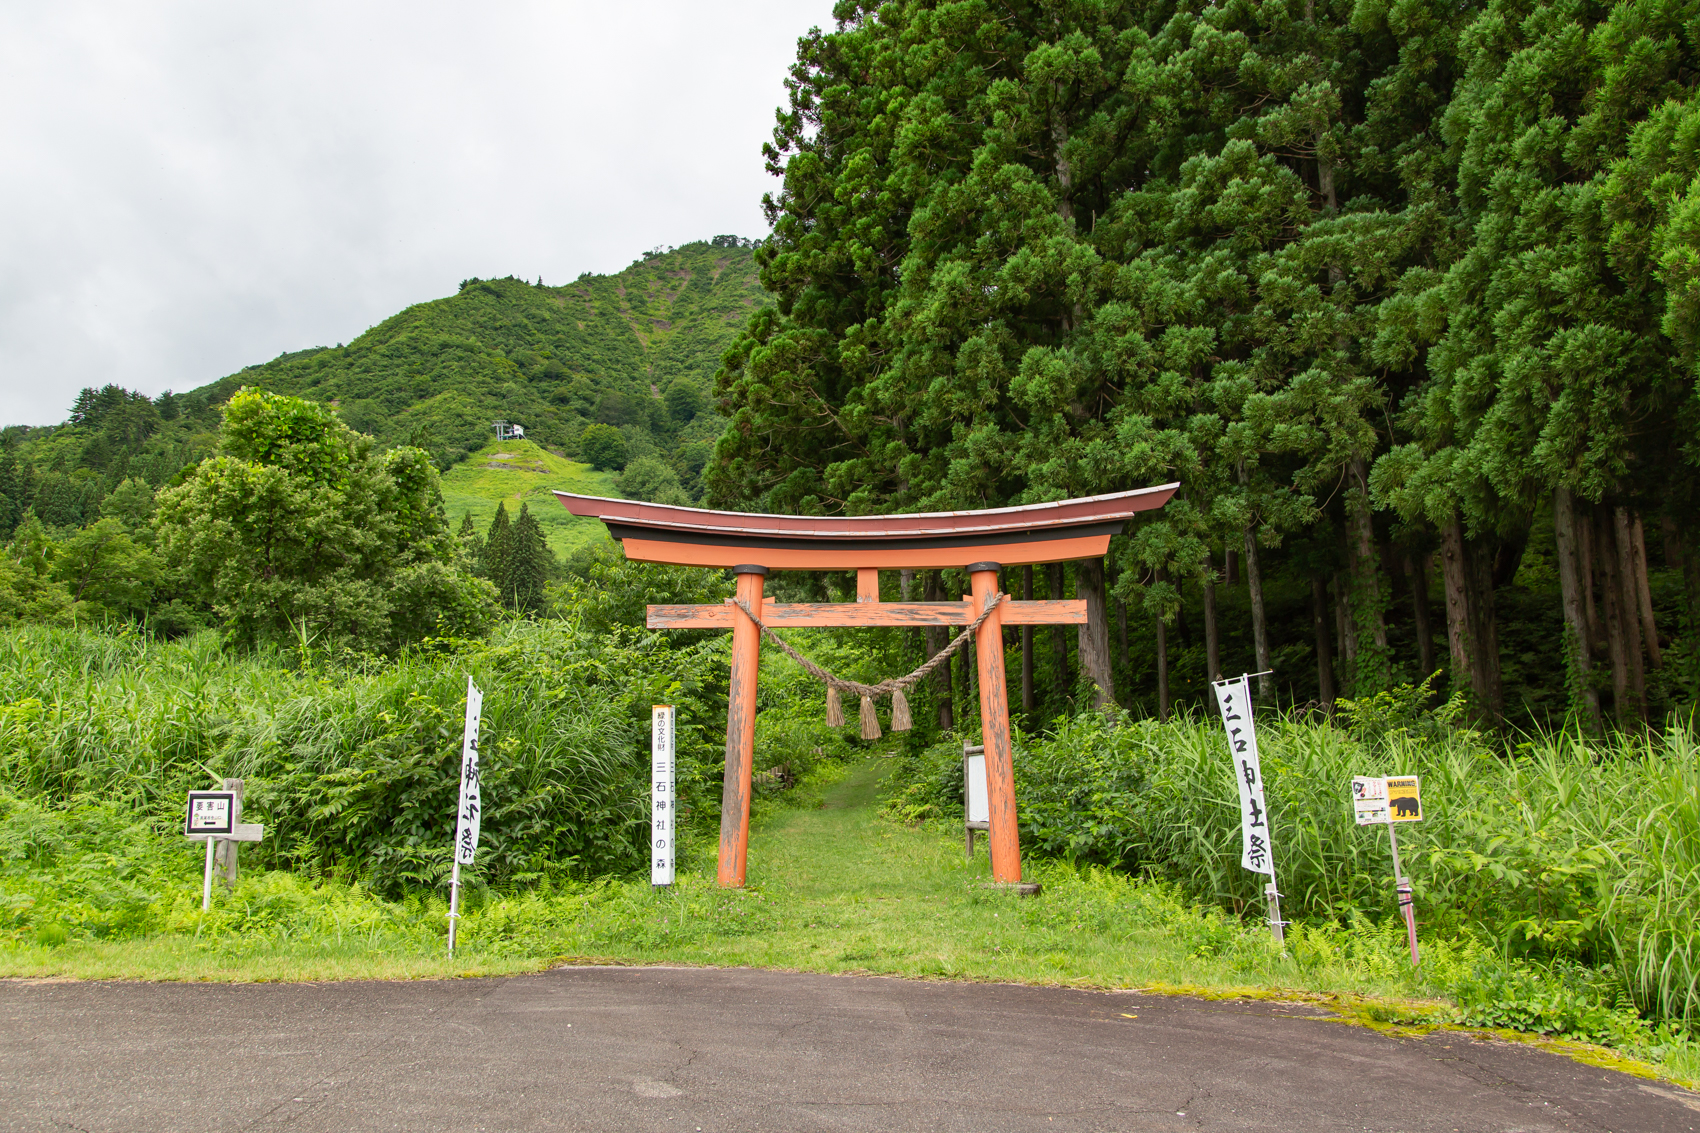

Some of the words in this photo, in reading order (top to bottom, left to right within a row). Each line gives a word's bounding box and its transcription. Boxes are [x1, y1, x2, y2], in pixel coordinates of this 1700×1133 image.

[657, 711, 666, 752] 緑の文化財
[195, 800, 226, 812] 要害山
[655, 761, 667, 870] 三石神社の森
